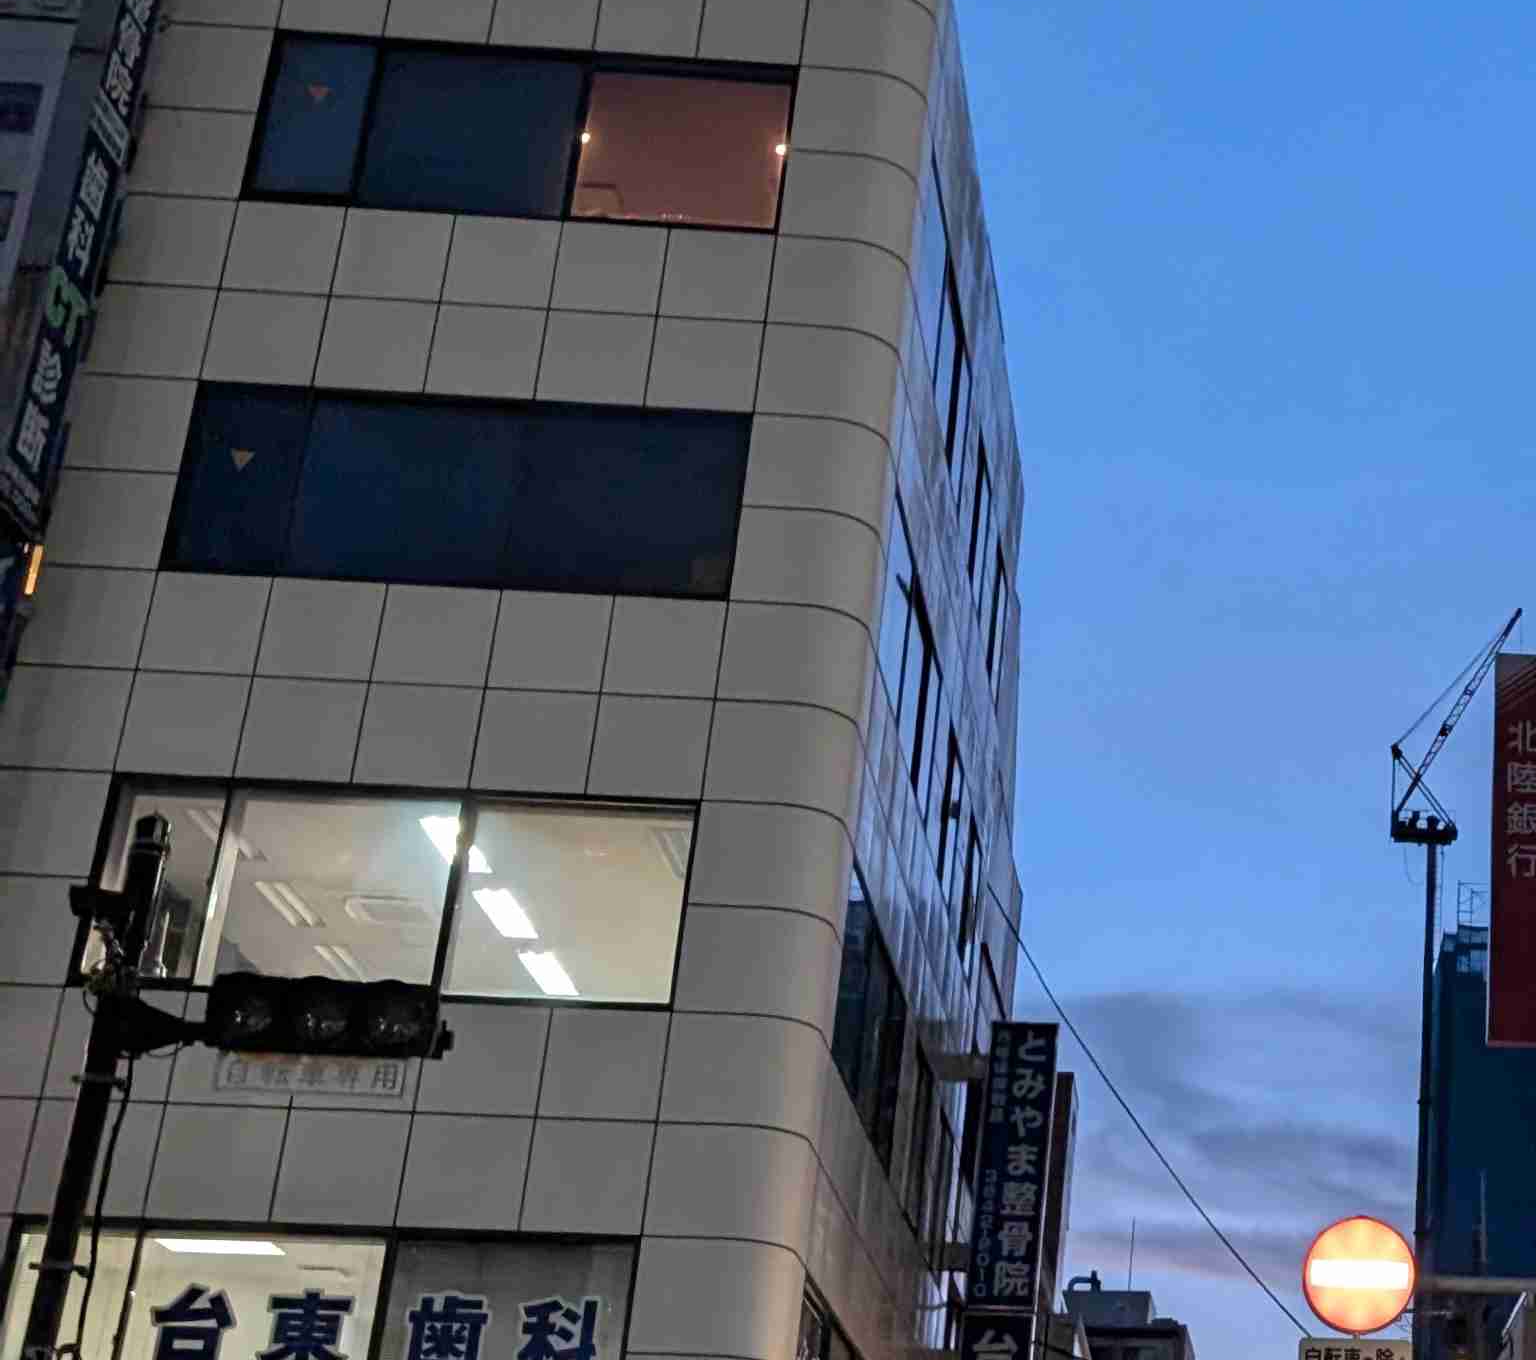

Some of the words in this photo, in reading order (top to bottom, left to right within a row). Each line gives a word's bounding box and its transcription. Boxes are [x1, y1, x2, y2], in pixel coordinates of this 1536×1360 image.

[992, 1030, 1047, 1297] とみやま整骨院
